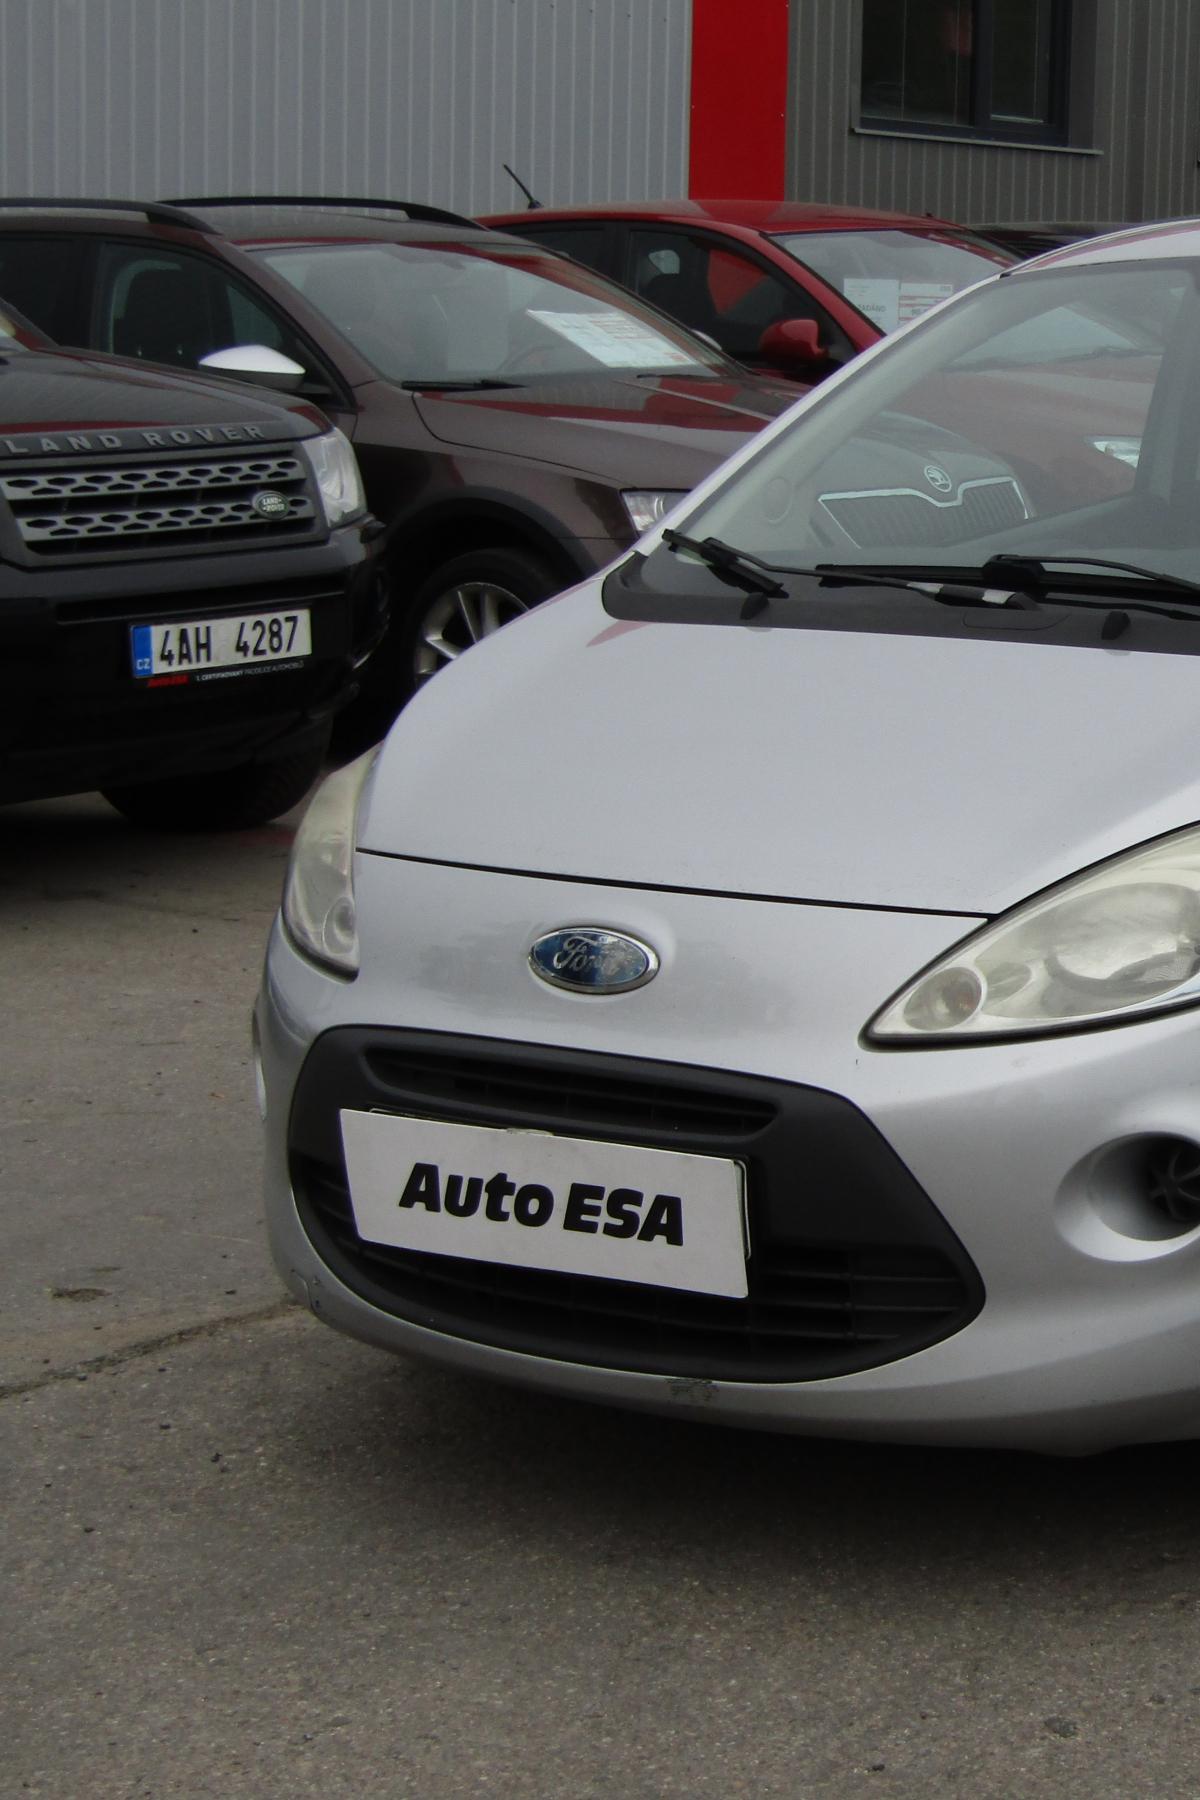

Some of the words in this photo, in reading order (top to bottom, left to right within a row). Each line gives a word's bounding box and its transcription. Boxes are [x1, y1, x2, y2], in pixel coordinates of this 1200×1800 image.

[5, 433, 122, 454] LAND
[142, 424, 266, 447] ROVER
[159, 625, 213, 667] 4AH
[235, 616, 299, 658] 4287
[136, 659, 151, 670] CZ
[398, 1162, 554, 1227] Auto
[562, 1182, 684, 1247] ESA
